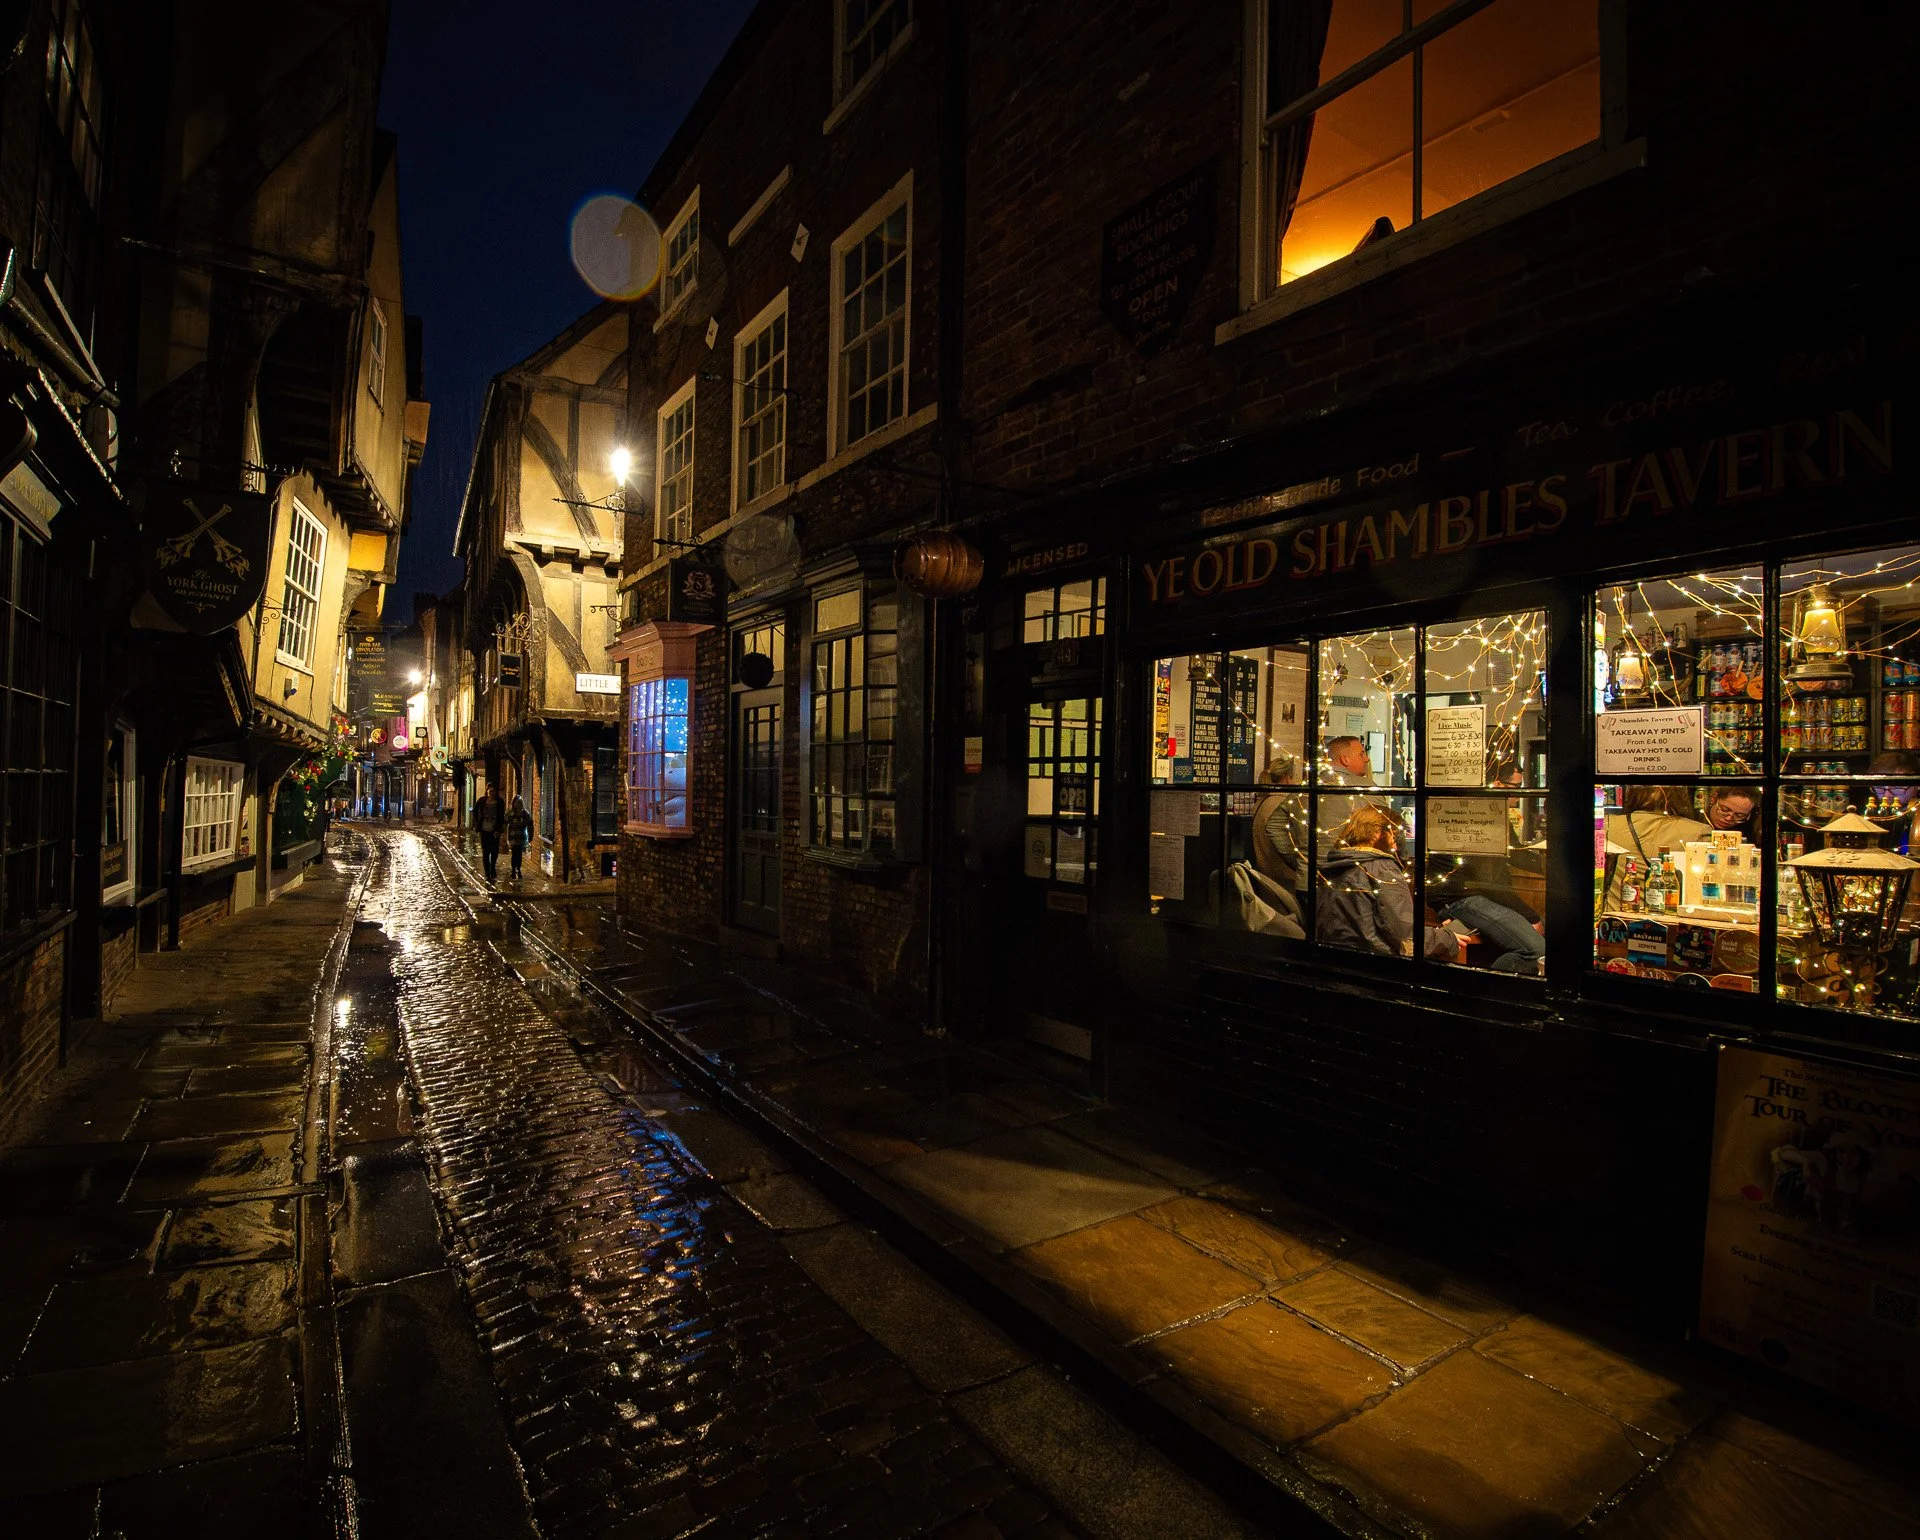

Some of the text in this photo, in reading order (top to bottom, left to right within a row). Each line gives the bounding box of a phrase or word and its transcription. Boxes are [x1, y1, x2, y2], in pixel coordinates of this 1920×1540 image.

[1128, 275, 1180, 314] OPEN
[1356, 452, 1421, 487] Food
[1141, 396, 1899, 602] YE OLD SHAMBLES TAVERN
[1007, 541, 1089, 576] LICENSED
[167, 576, 240, 595] YORK GHOST
[580, 678, 609, 688] LITTLE
[1454, 721, 1473, 729] Music
[1611, 727, 1686, 736] TAKEAWAY PINTS
[1626, 738, 1644, 746] From
[1633, 933, 1663, 942] SALTAIRE
[1760, 1075, 1810, 1102] THE
[1744, 1094, 1813, 1128] TOUR
[1814, 1115, 1858, 1131] OF
